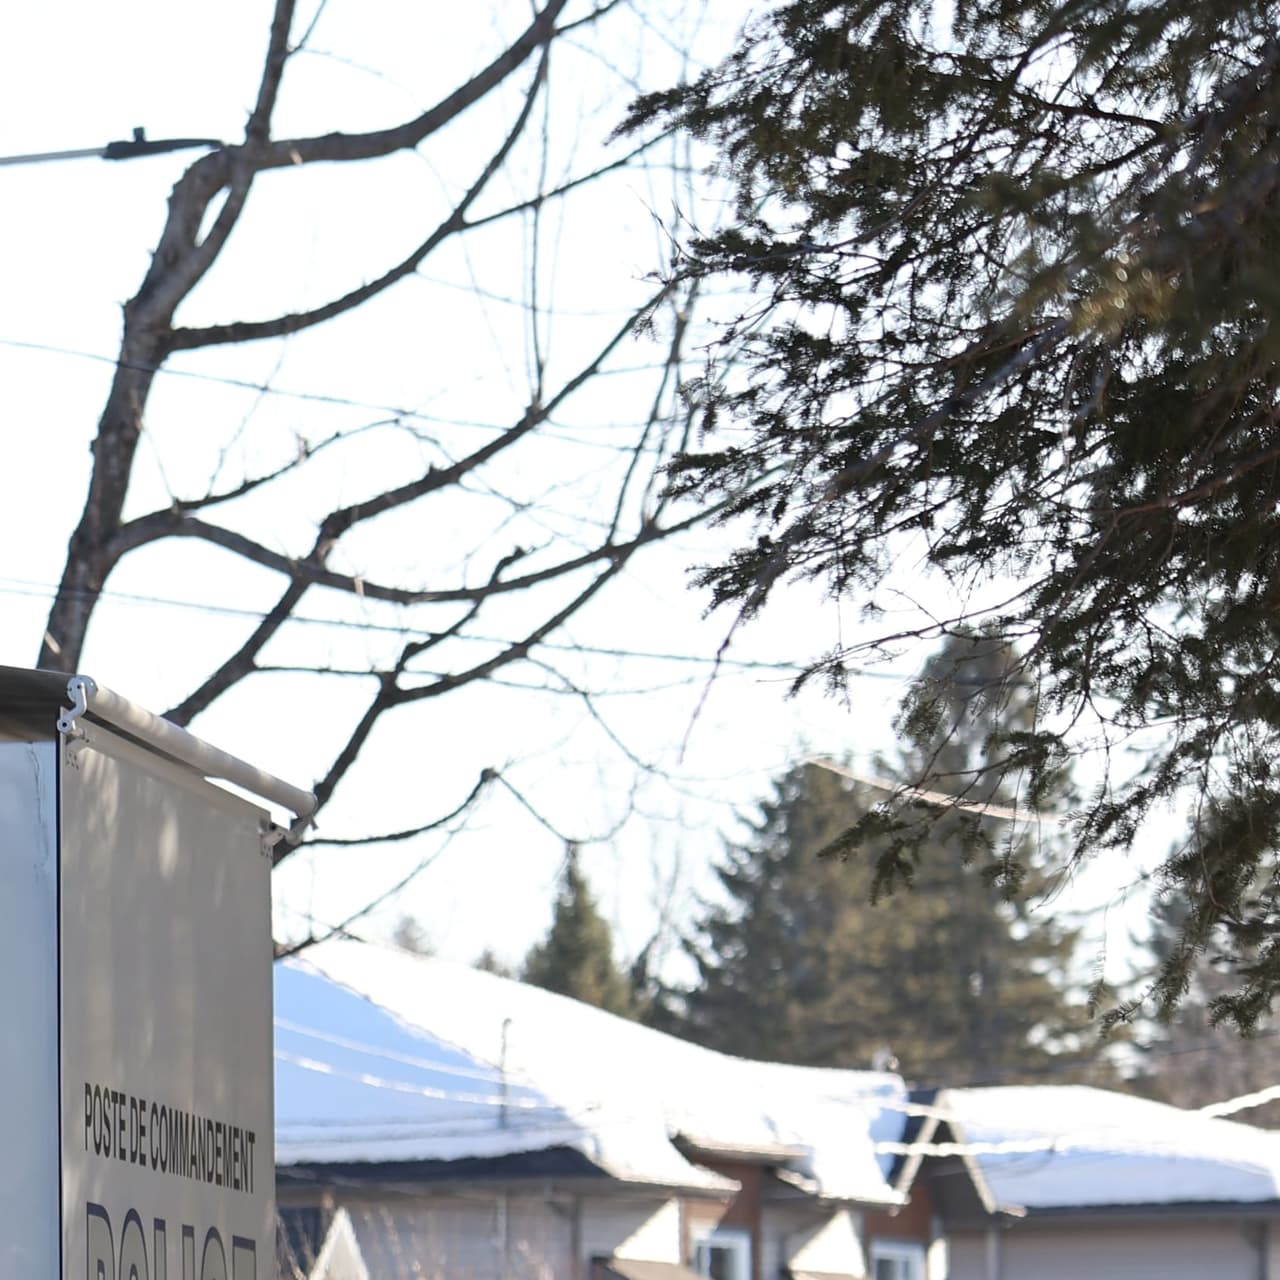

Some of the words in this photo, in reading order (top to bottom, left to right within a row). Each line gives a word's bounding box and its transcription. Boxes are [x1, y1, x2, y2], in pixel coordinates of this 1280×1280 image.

[84, 1081, 127, 1162] POSTE
[130, 1096, 147, 1167] DE
[150, 1102, 256, 1195] COMMANDEMENT
